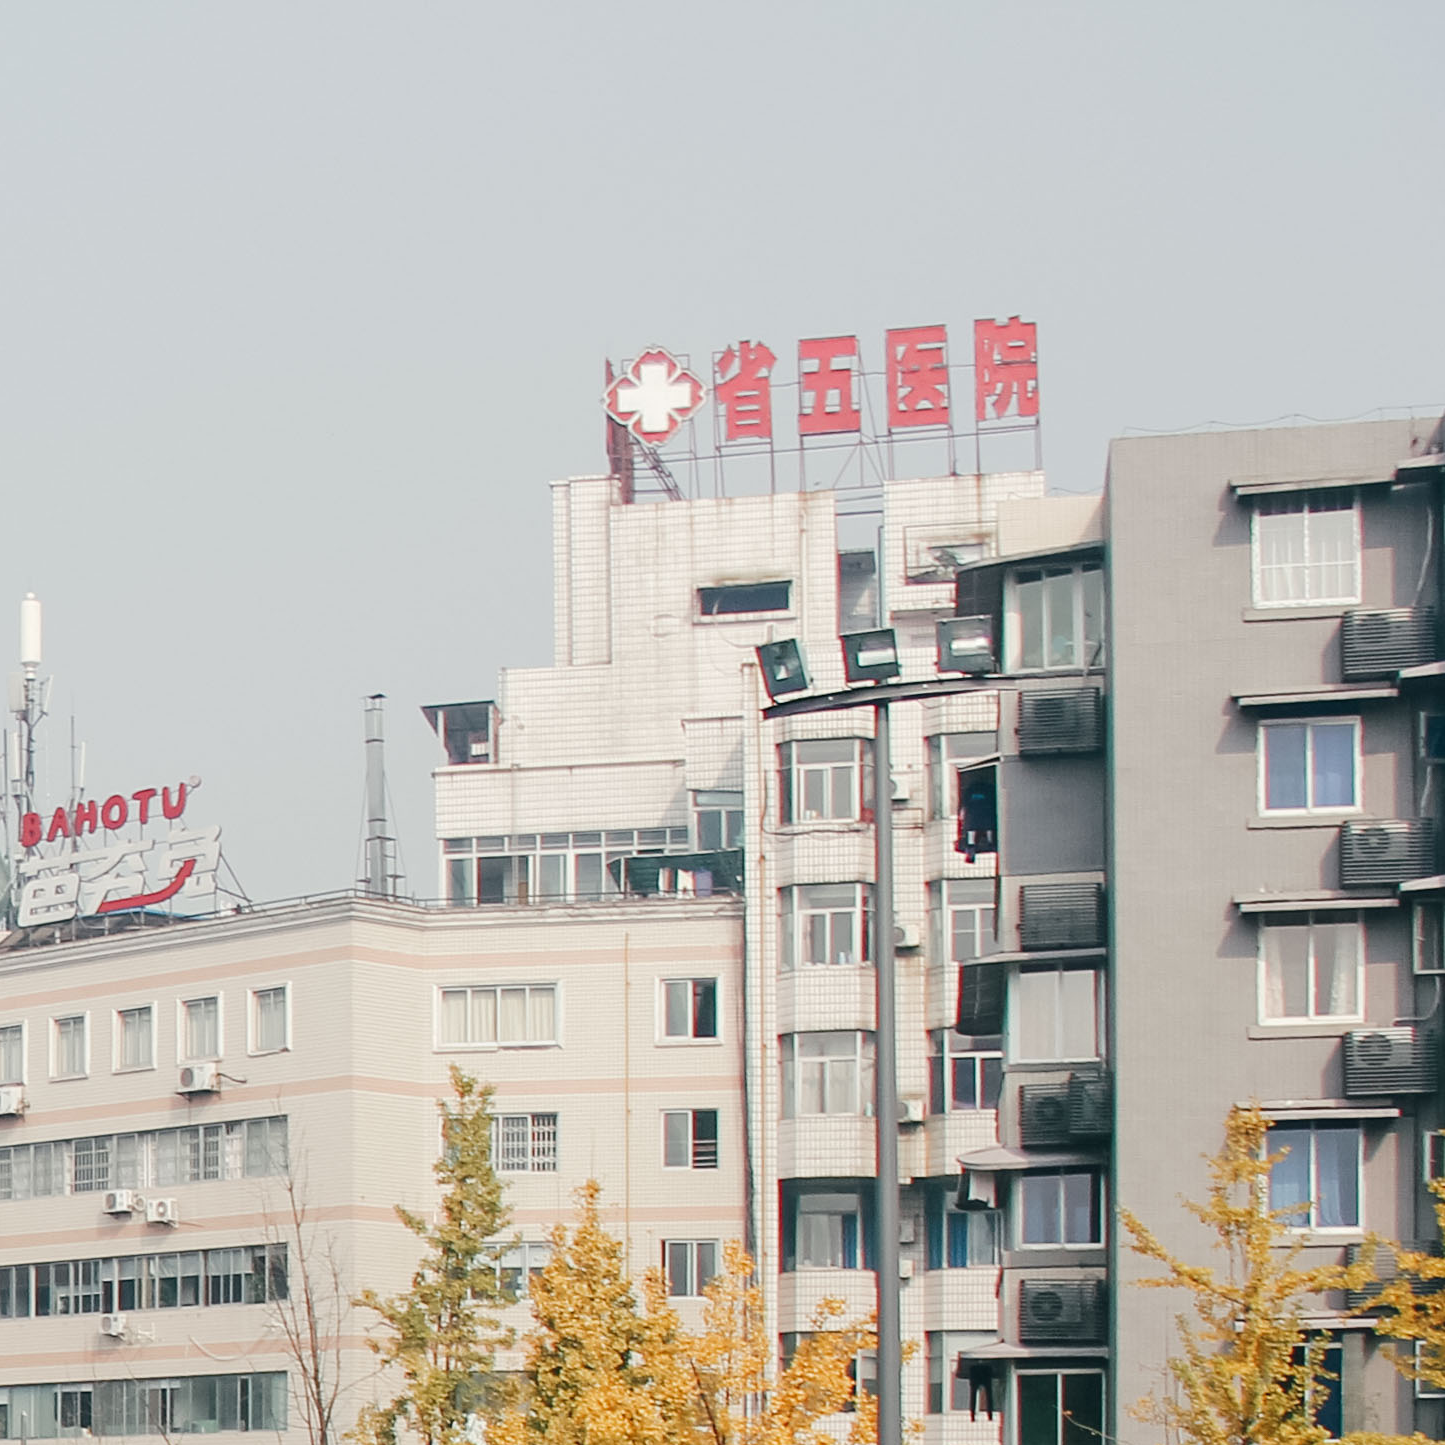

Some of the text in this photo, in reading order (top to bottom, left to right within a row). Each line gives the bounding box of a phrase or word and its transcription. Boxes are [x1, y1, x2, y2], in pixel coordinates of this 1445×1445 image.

[713, 315, 1040, 441] 省五医院
[19, 782, 189, 849] BAHOTU
